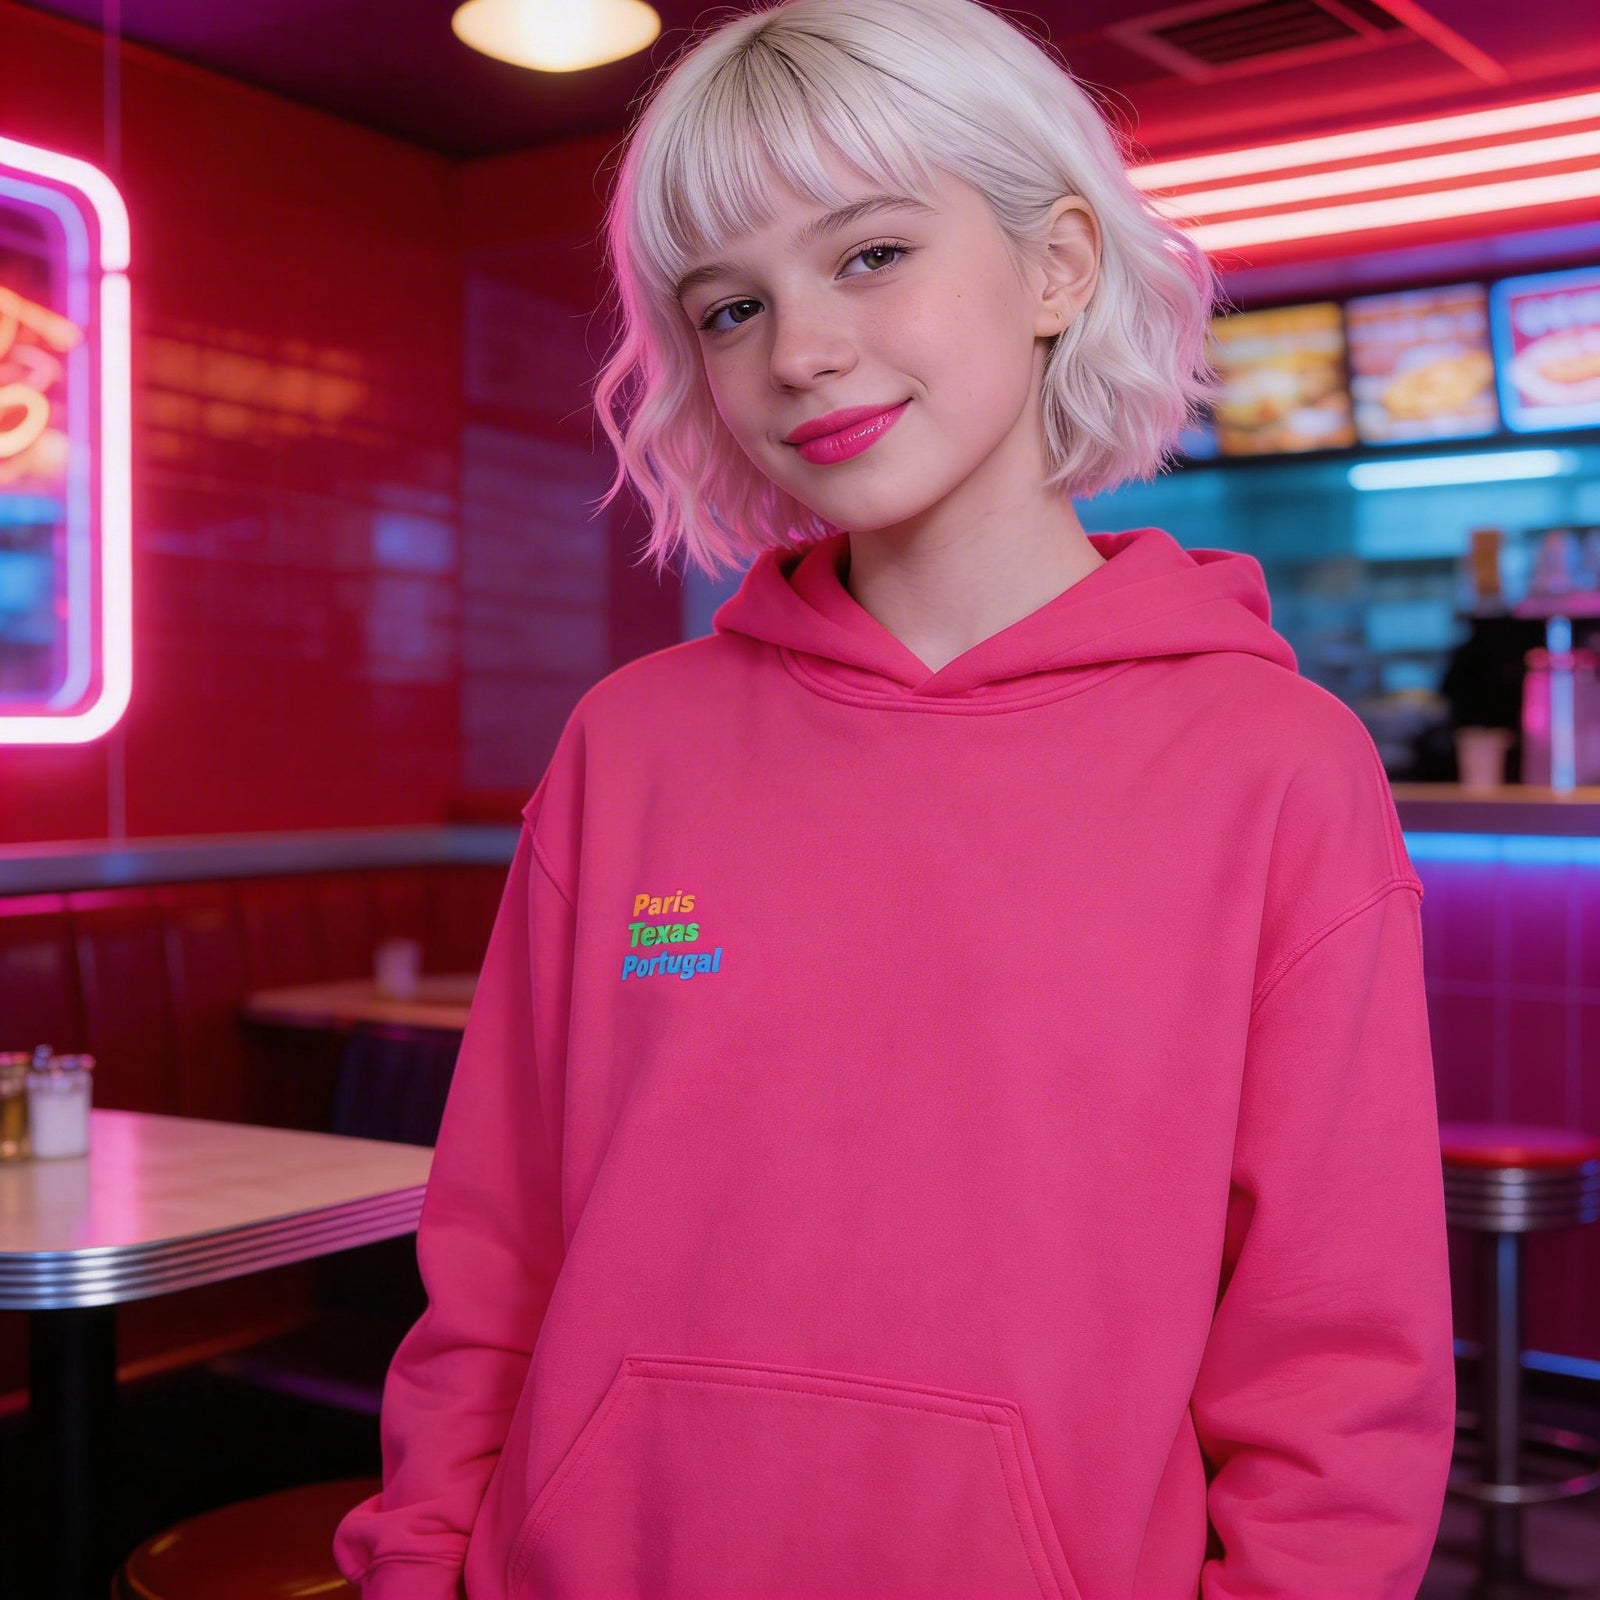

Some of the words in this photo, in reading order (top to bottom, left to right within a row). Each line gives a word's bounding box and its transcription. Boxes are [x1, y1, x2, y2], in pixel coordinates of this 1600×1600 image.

[633, 890, 695, 917] Paris
[628, 922, 699, 948] Texas
[622, 947, 722, 981] Portugal
